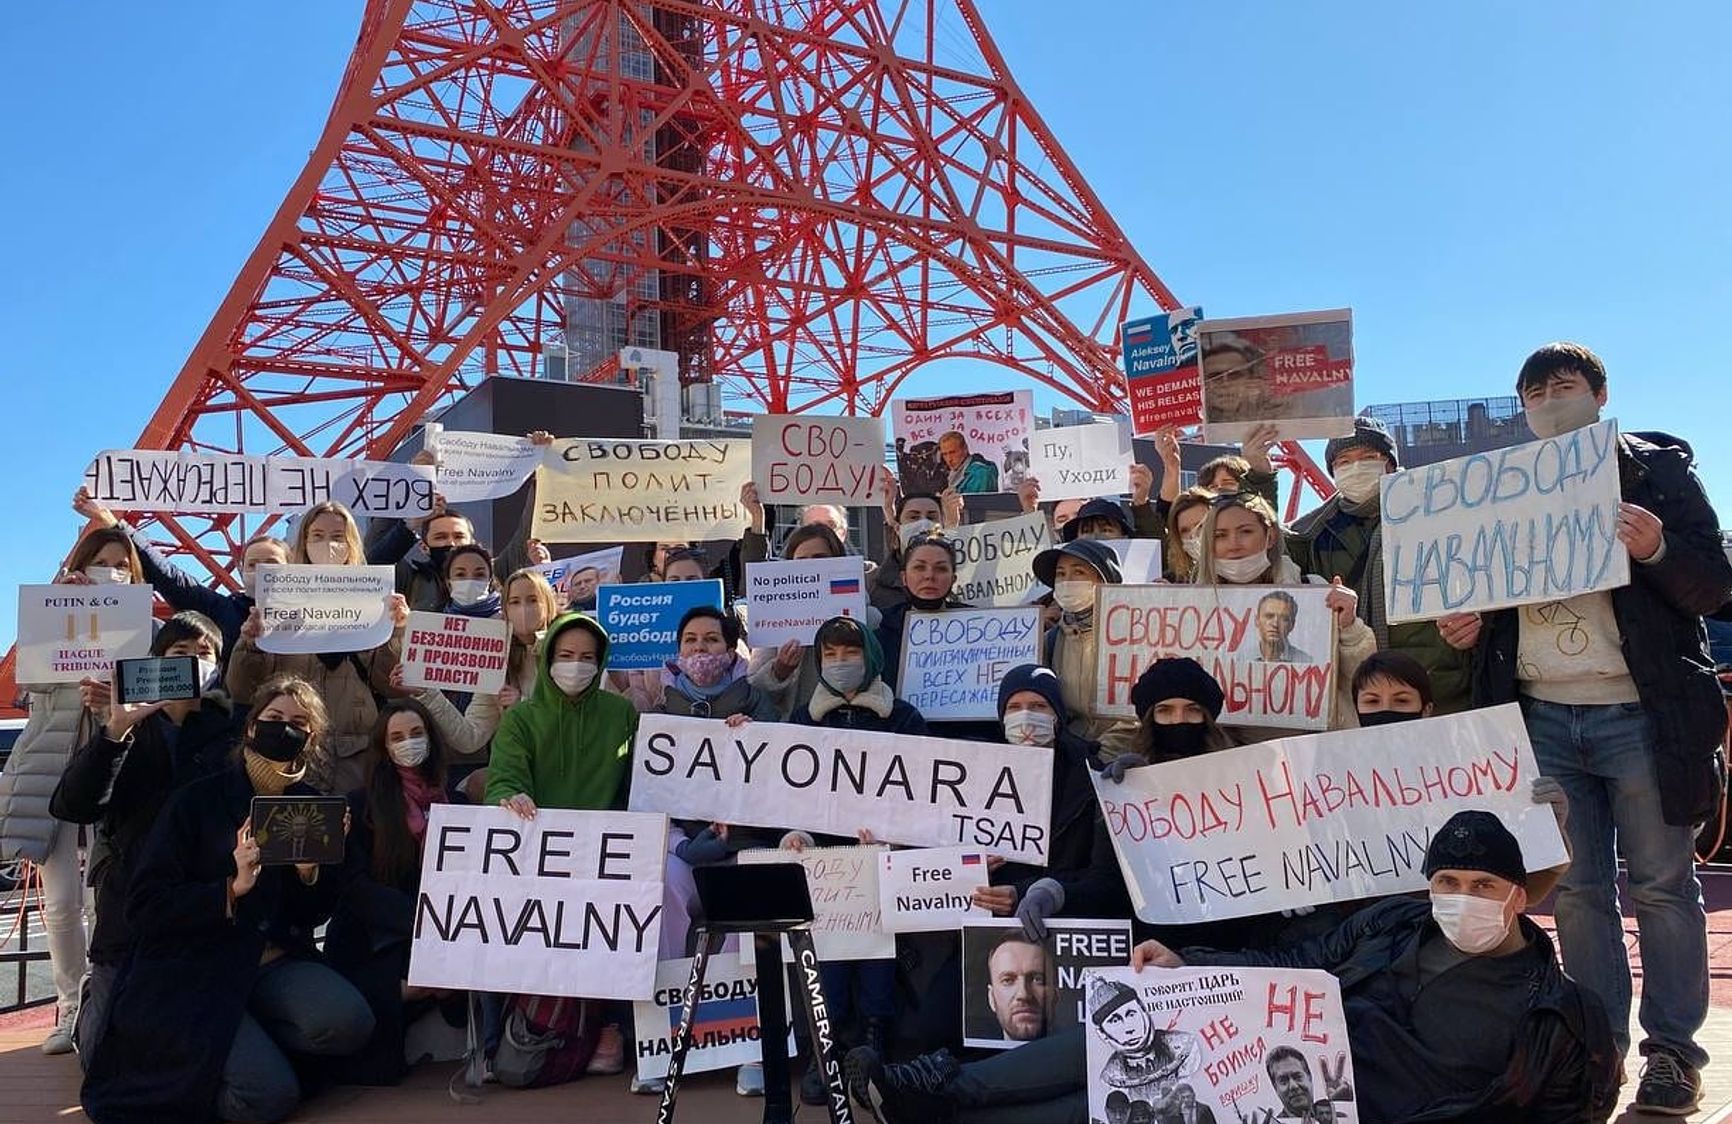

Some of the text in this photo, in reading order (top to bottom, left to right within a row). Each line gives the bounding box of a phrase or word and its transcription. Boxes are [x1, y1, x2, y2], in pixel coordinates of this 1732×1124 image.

[1131, 343, 1171, 358] Aleksey
[1274, 353, 1315, 368] FREE
[1133, 354, 1181, 371] Navalny
[1135, 387, 1153, 397] WE
[1137, 399, 1155, 411] HIS
[904, 414, 943, 424] ОДИН
[949, 411, 965, 421] ЗА
[782, 423, 865, 459] СВО-
[910, 427, 935, 442] ВСЕ
[951, 423, 965, 432] ЗА
[562, 441, 730, 464] СВОБОДУ
[1044, 443, 1073, 460] Пу,
[85, 455, 433, 511] ВСЕХ НЕ ПЕРЕСАЖАЕТЕ
[592, 471, 726, 492] ПОЛИТ-
[770, 462, 876, 499] БОДУ!
[1059, 468, 1119, 484] Уходи
[1383, 421, 1617, 525] СВОБОДУ
[542, 499, 747, 524] ЗАКЛЮЧЁННЫ
[952, 523, 1045, 565] ВОБОДУ
[1387, 498, 1620, 616] НАВАЛЬНОМУ
[263, 573, 312, 585] Свободу
[753, 574, 820, 587] No political
[45, 597, 119, 608] PUTIN & Co
[608, 593, 673, 607] Россия
[754, 590, 820, 603] repression!
[264, 607, 362, 621] Free Navalny
[443, 616, 470, 632] НЕТ
[608, 611, 660, 627] будет
[909, 616, 1037, 646] СВОБОДУ
[1105, 604, 1252, 653] СВОБОДУ
[410, 630, 504, 653] БЕЗЗАКОНИЮ
[59, 649, 105, 659] HAGUE
[407, 647, 505, 670] И ПРОИЗВОЛУ
[424, 667, 480, 685] ВЛАСТИ
[923, 661, 1010, 688] ВСЕХ НЕ
[643, 733, 1025, 814] SAYONARA
[1104, 783, 1244, 842] ВОБОДУ
[952, 815, 1045, 855] TSAR
[436, 826, 635, 881] FREE
[1171, 826, 1430, 904] FREE NAVALNY
[912, 867, 953, 882] Free
[896, 893, 973, 912] Navalny
[415, 892, 662, 952] NAVALNY
[1056, 934, 1128, 957] FREE
[654, 978, 758, 1007] СВБОДУ
[1144, 973, 1240, 998] ГОВОРЯТ, ЦАРЬ
[801, 949, 834, 1055] CAMERA
[1147, 1001, 1163, 1013] НЕ
[1265, 981, 1329, 1045] НЕ
[1199, 1015, 1239, 1052] НЕ
[1203, 1035, 1267, 1088] БОИМСЯ
